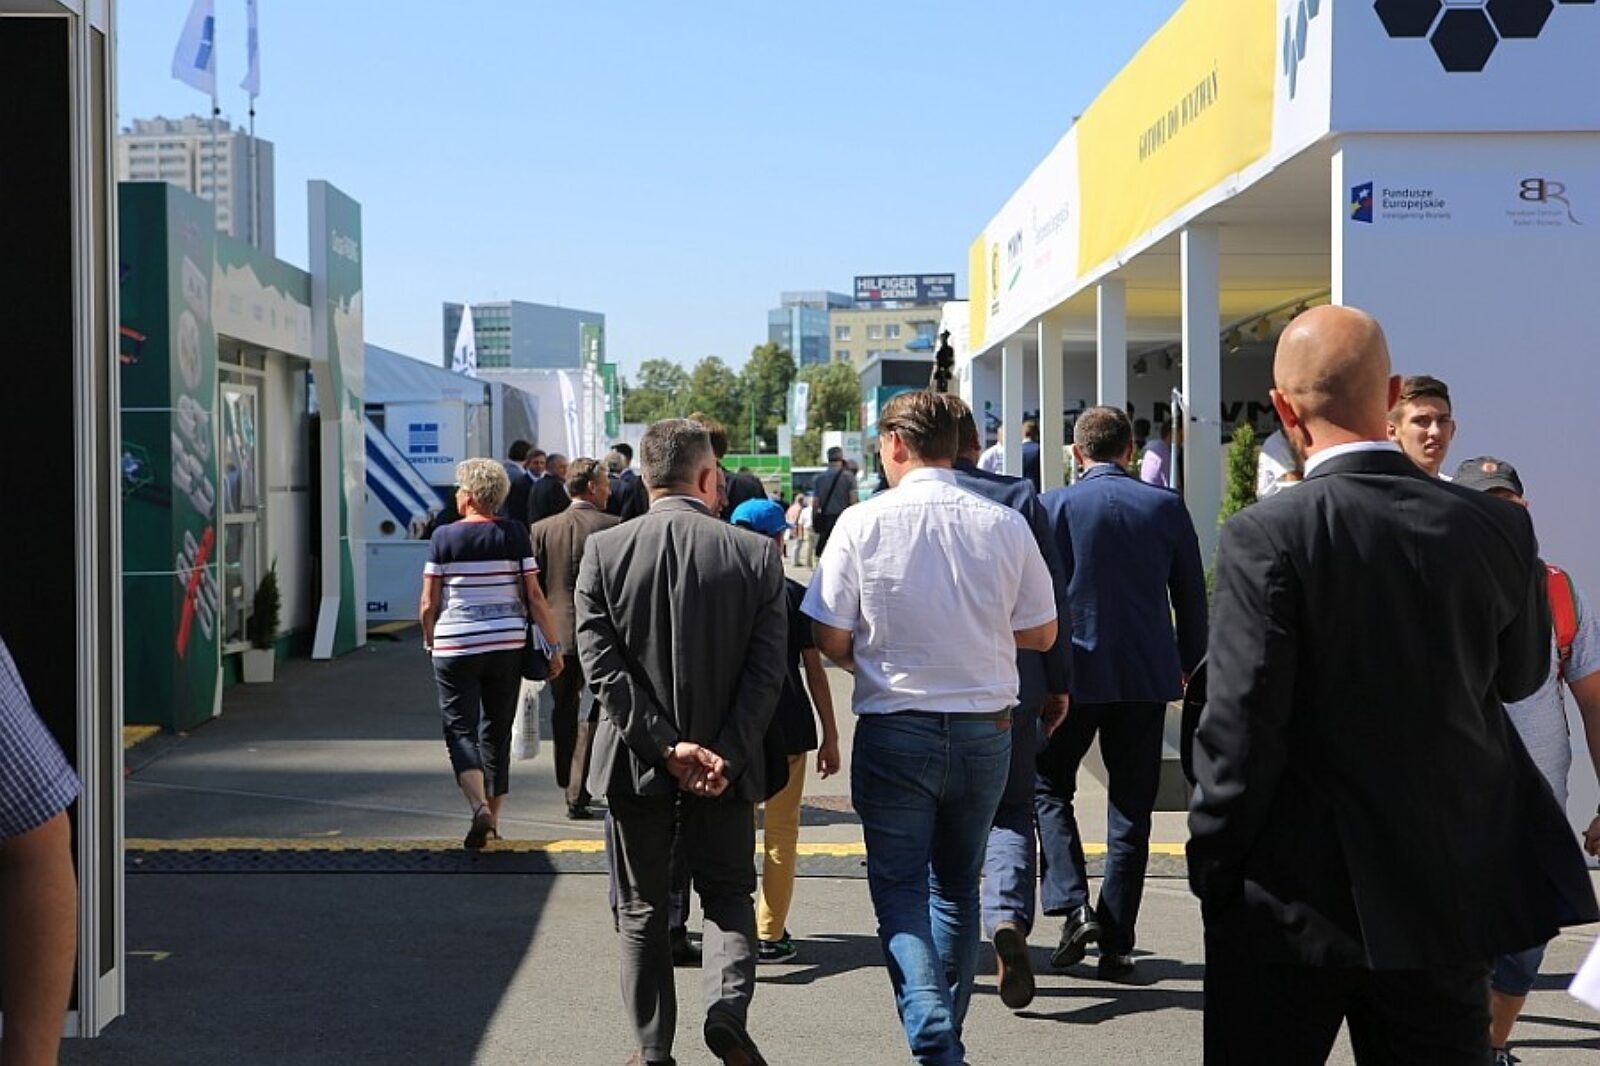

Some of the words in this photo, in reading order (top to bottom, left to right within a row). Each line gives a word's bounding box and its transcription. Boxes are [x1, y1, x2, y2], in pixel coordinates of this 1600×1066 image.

[1382, 188, 1433, 198] Fundusze
[1382, 199, 1446, 211] Europejskie
[857, 277, 917, 290] HILFIGER
